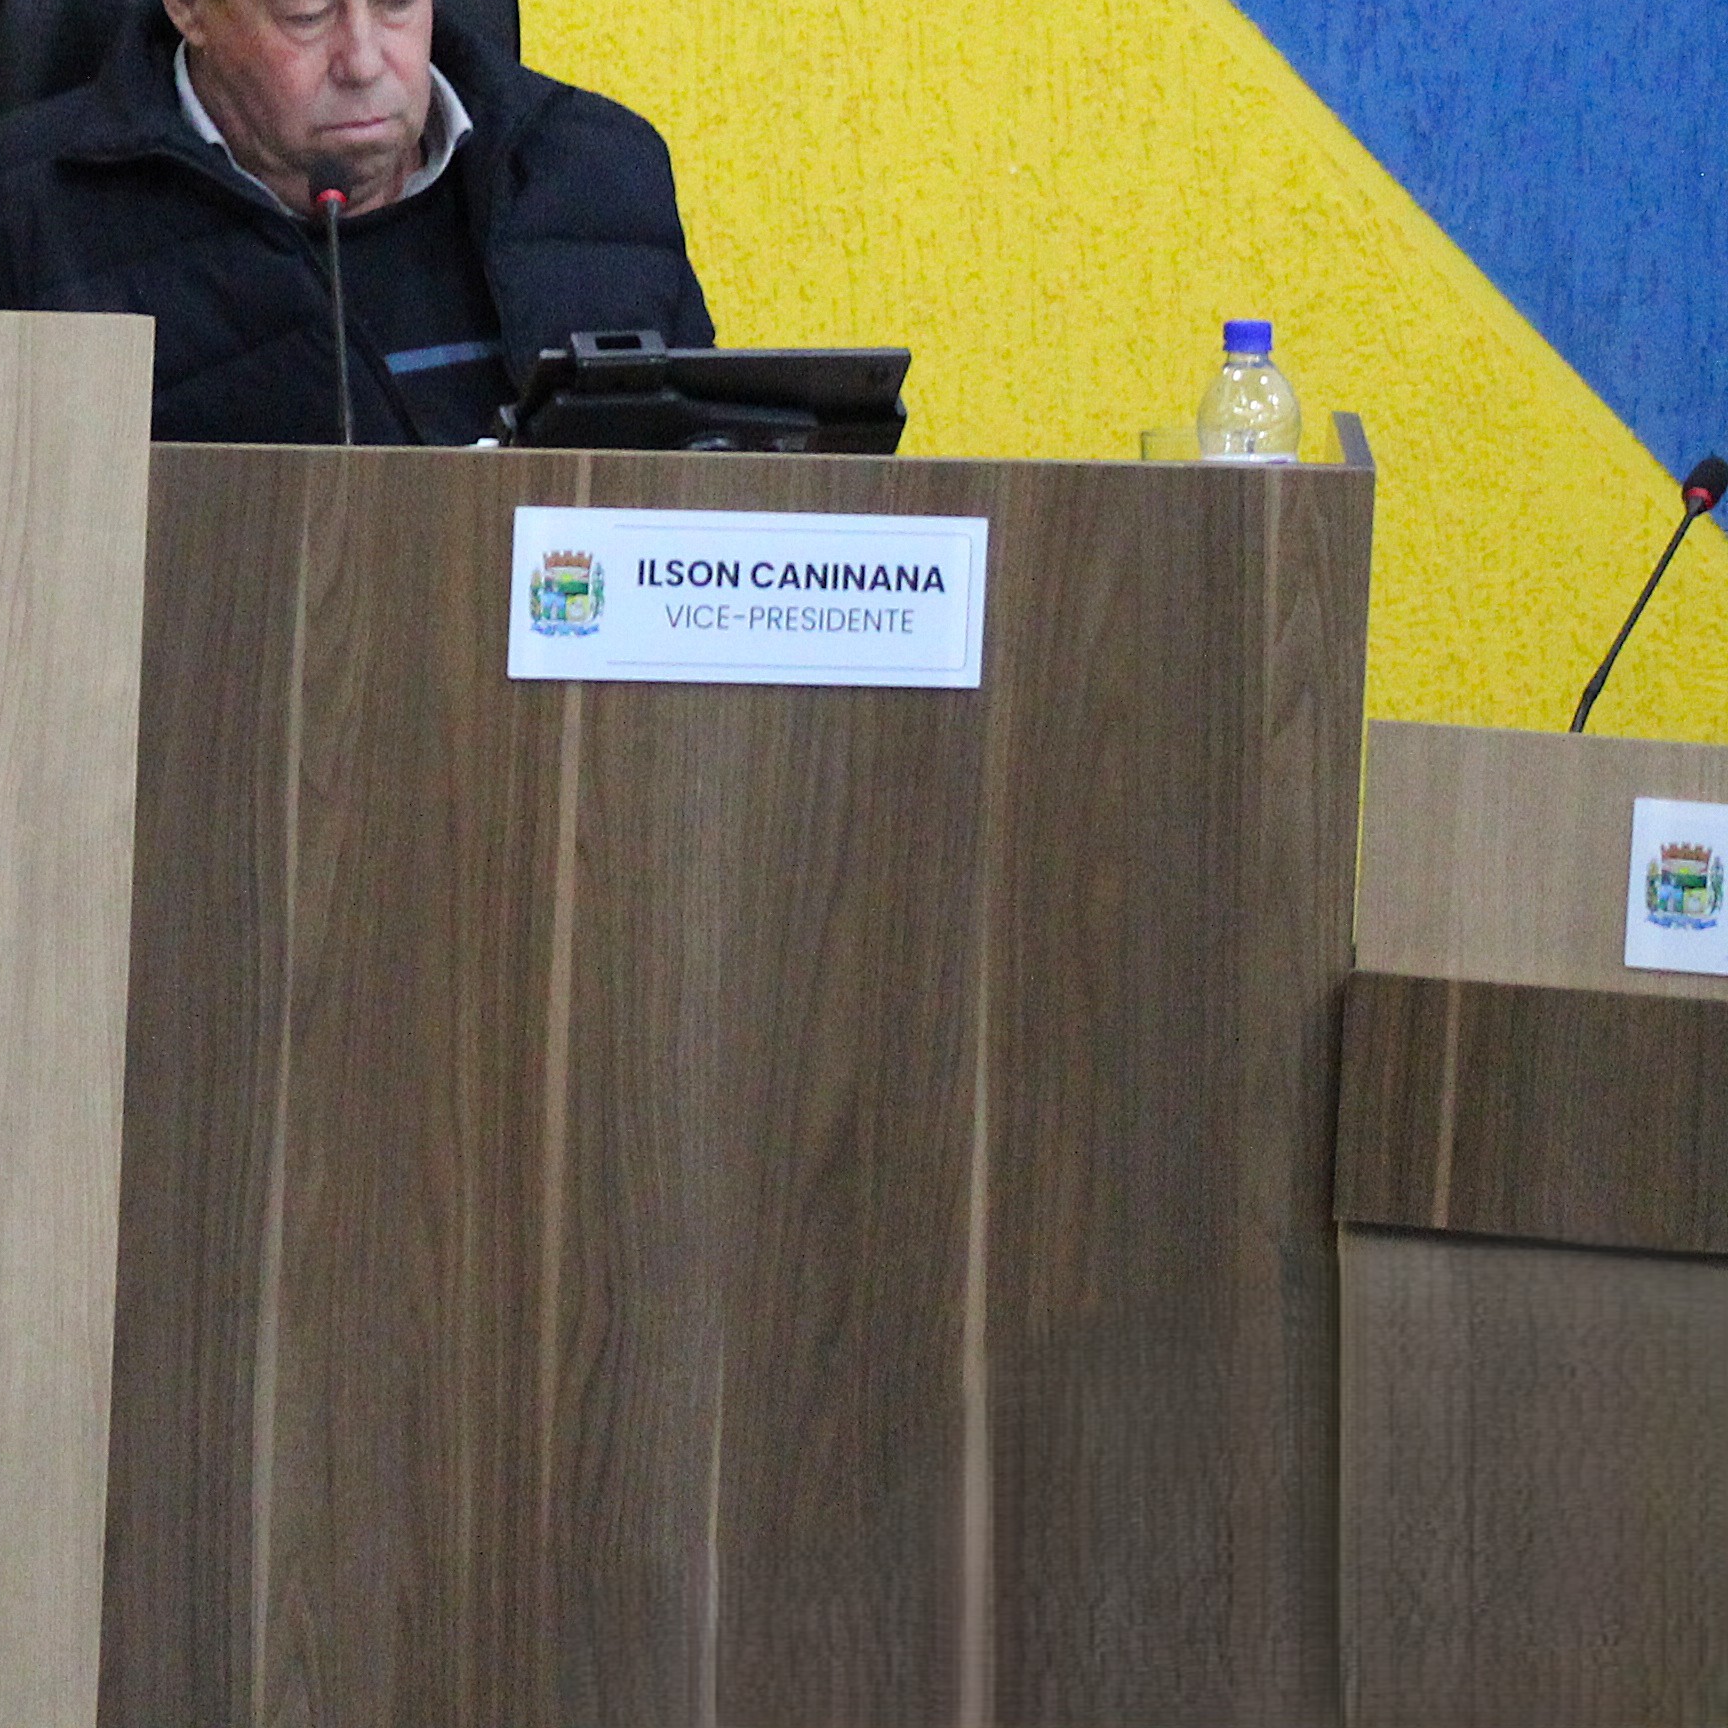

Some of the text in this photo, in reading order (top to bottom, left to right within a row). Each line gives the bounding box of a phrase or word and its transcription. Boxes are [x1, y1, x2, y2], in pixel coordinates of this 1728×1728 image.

[638, 558, 946, 593] ILSON CANINANA
[666, 604, 915, 633] VICE-PRESIDENTE
